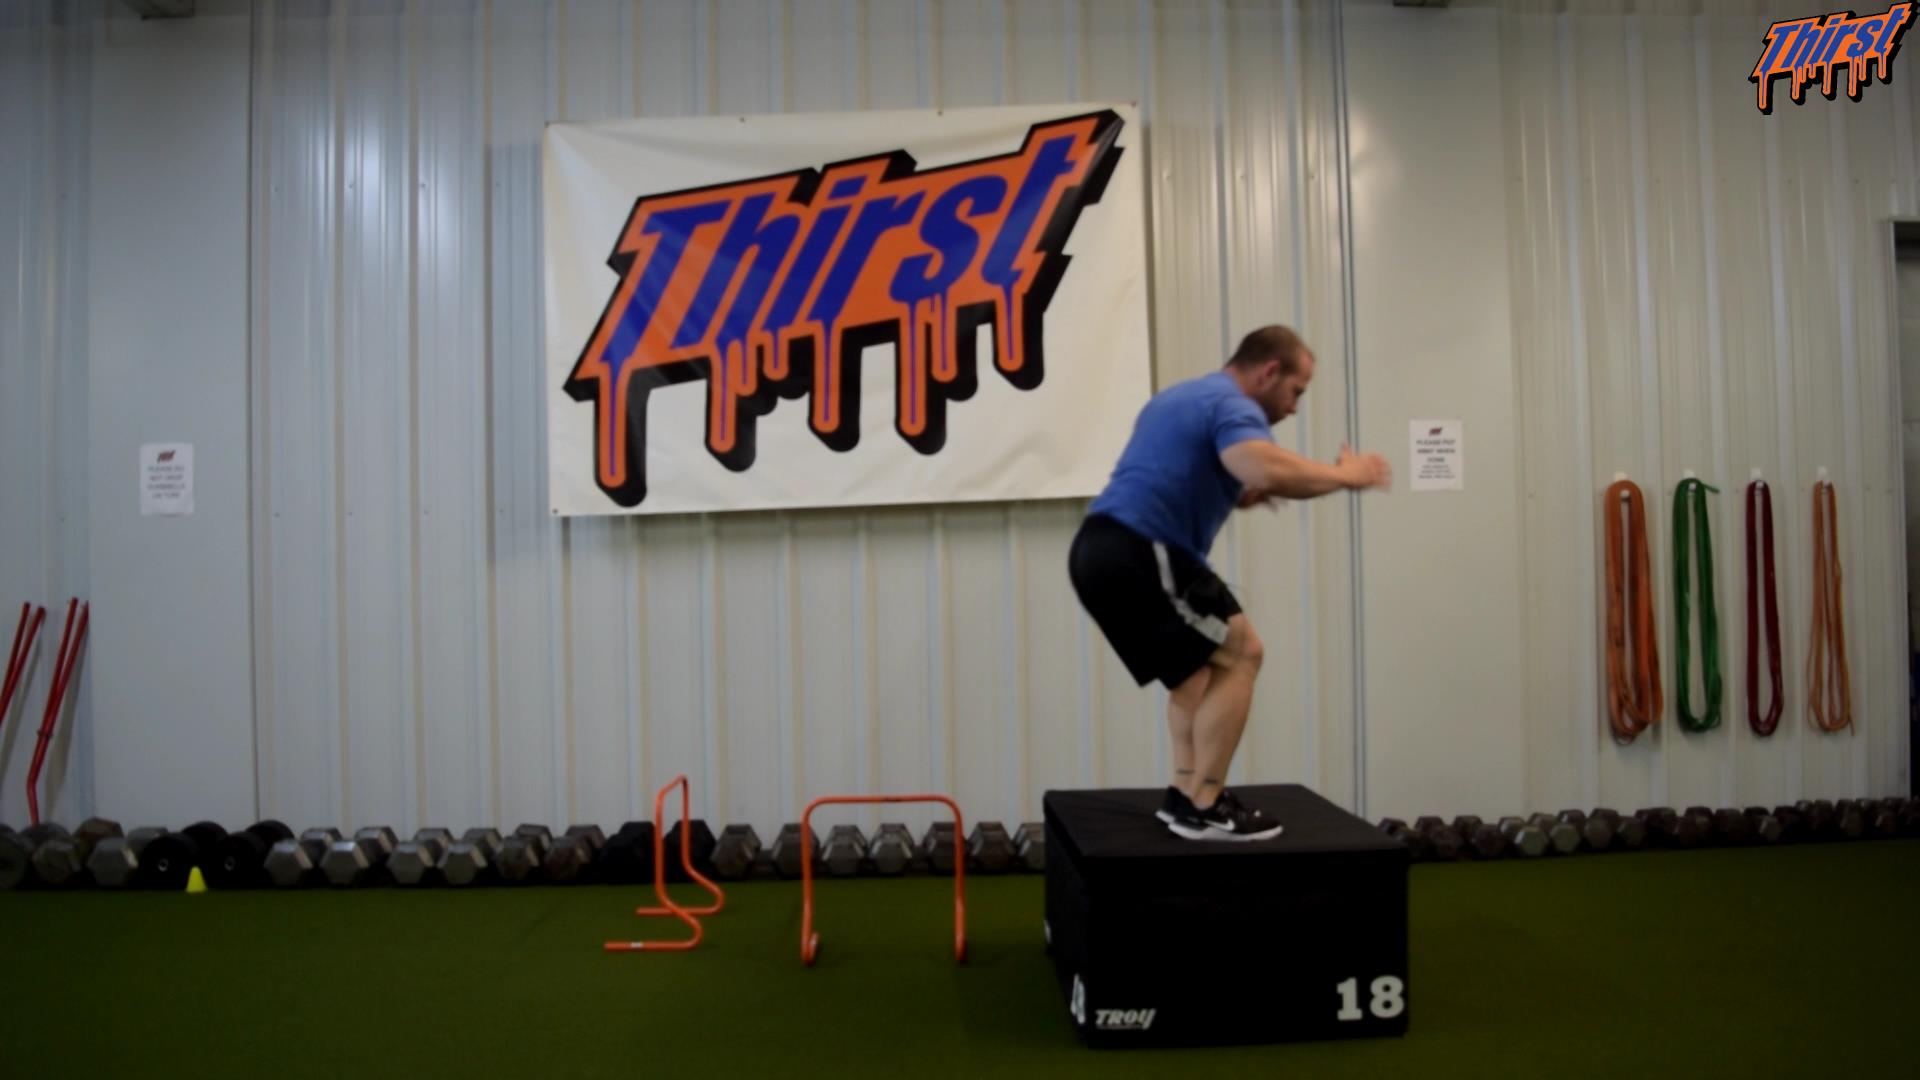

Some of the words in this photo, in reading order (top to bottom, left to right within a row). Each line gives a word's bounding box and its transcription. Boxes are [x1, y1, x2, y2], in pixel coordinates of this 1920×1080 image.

[582, 118, 1100, 462] Thirst
[1095, 1008, 1157, 1030] TROY
[1336, 975, 1405, 1021] 18
